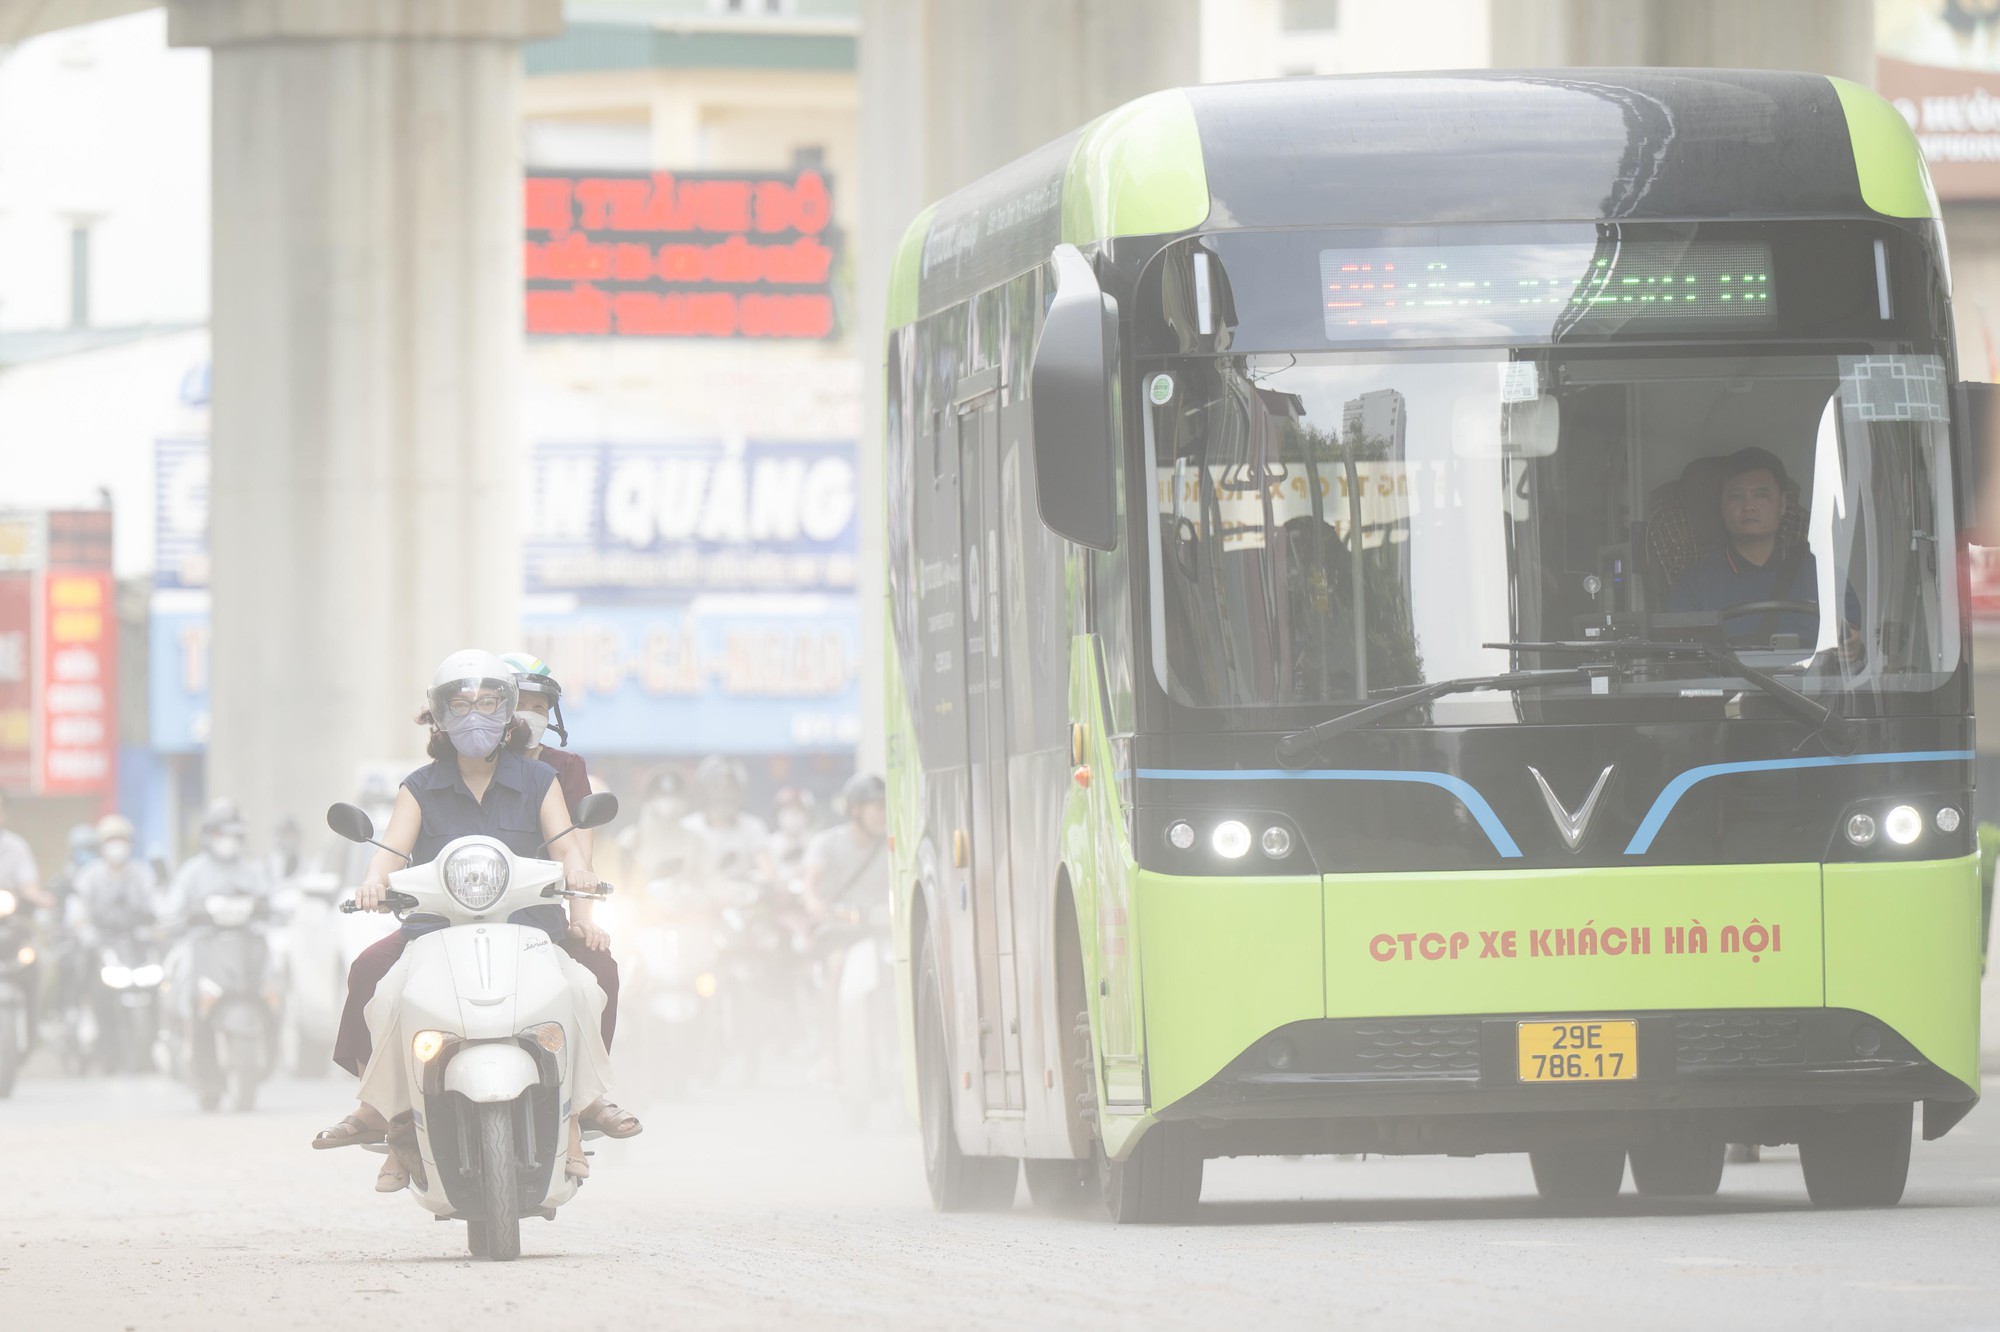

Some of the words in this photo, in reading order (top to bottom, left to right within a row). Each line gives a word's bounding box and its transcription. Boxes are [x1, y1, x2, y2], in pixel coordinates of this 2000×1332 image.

[1369, 932, 1470, 962] CTCP
[1479, 930, 1517, 959] XE
[1530, 919, 1651, 957] KHÁCH
[1664, 918, 1708, 955] HÀ
[1720, 917, 1781, 964] NỘI
[1552, 1025, 1603, 1050] 29E
[1532, 1053, 1624, 1079] 786.17
